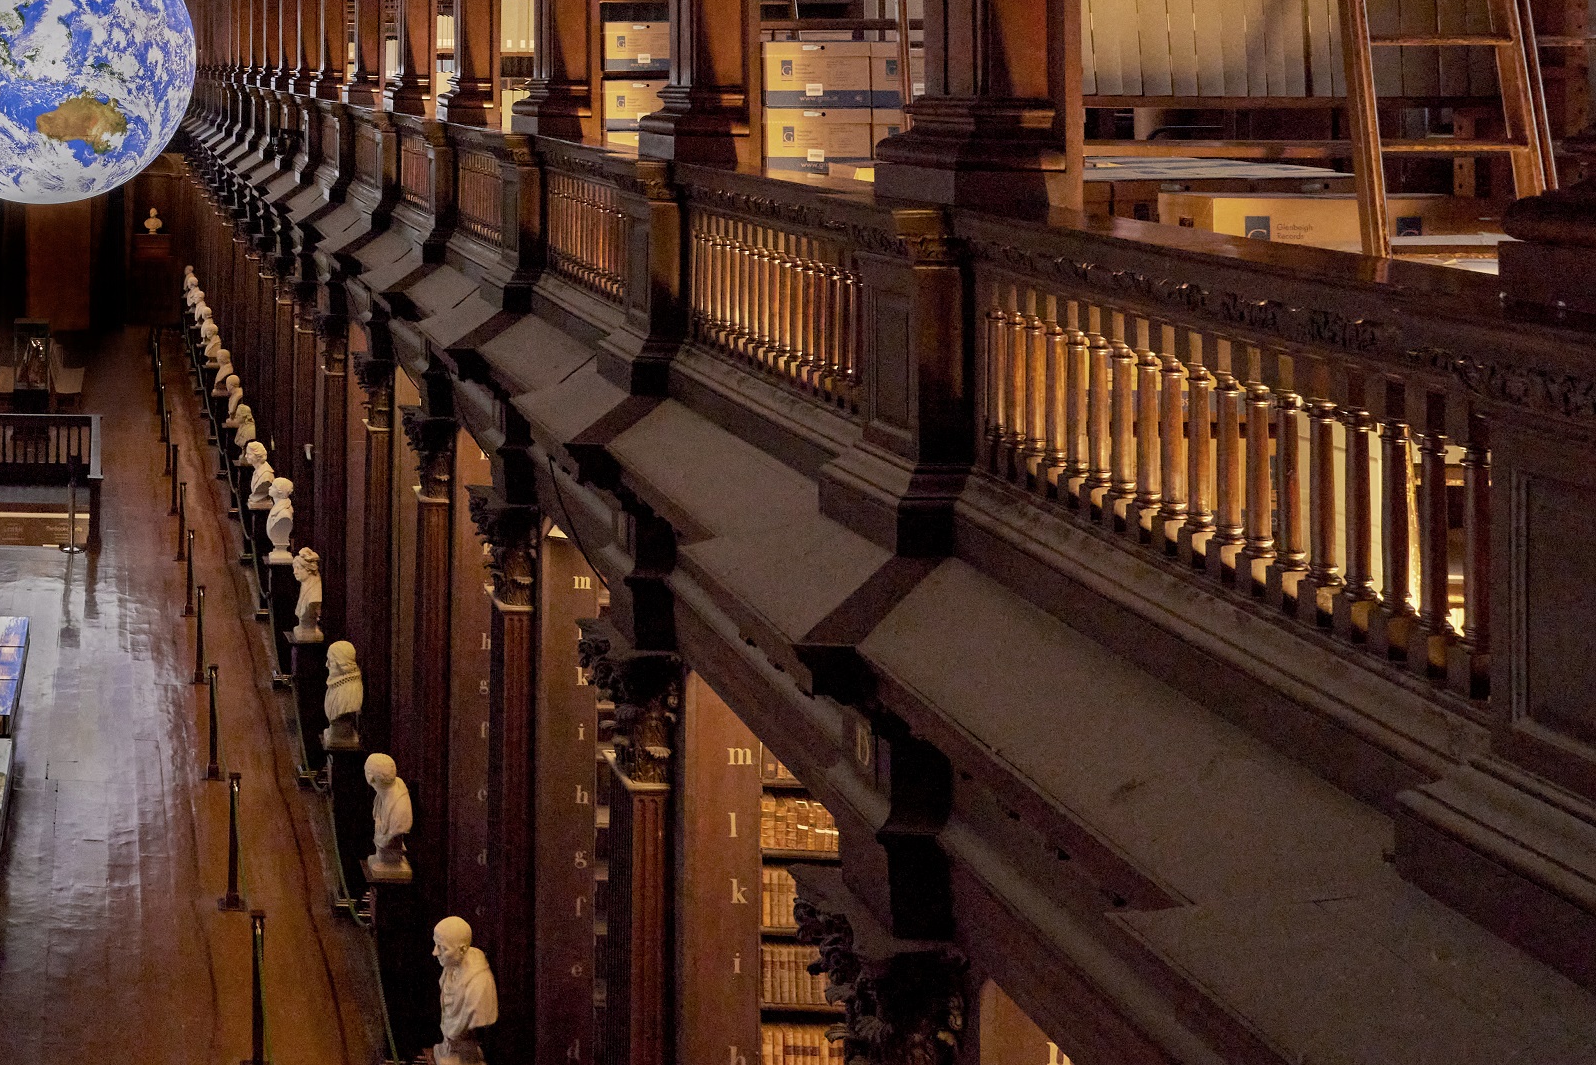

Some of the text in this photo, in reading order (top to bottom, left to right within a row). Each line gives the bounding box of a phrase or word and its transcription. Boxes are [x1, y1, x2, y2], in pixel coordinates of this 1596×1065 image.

[1276, 223, 1314, 233] Glenbeigh
[573, 575, 592, 590] m
[575, 666, 589, 686] k
[578, 722, 586, 741] i
[727, 747, 753, 765] m
[477, 788, 488, 801] e
[575, 785, 589, 805] h
[728, 812, 739, 838] l
[478, 848, 488, 865] d
[574, 849, 588, 869] g
[730, 878, 749, 904] k
[575, 896, 587, 917] f
[571, 963, 583, 978] e
[732, 952, 742, 974] i
[566, 1038, 581, 1061] d
